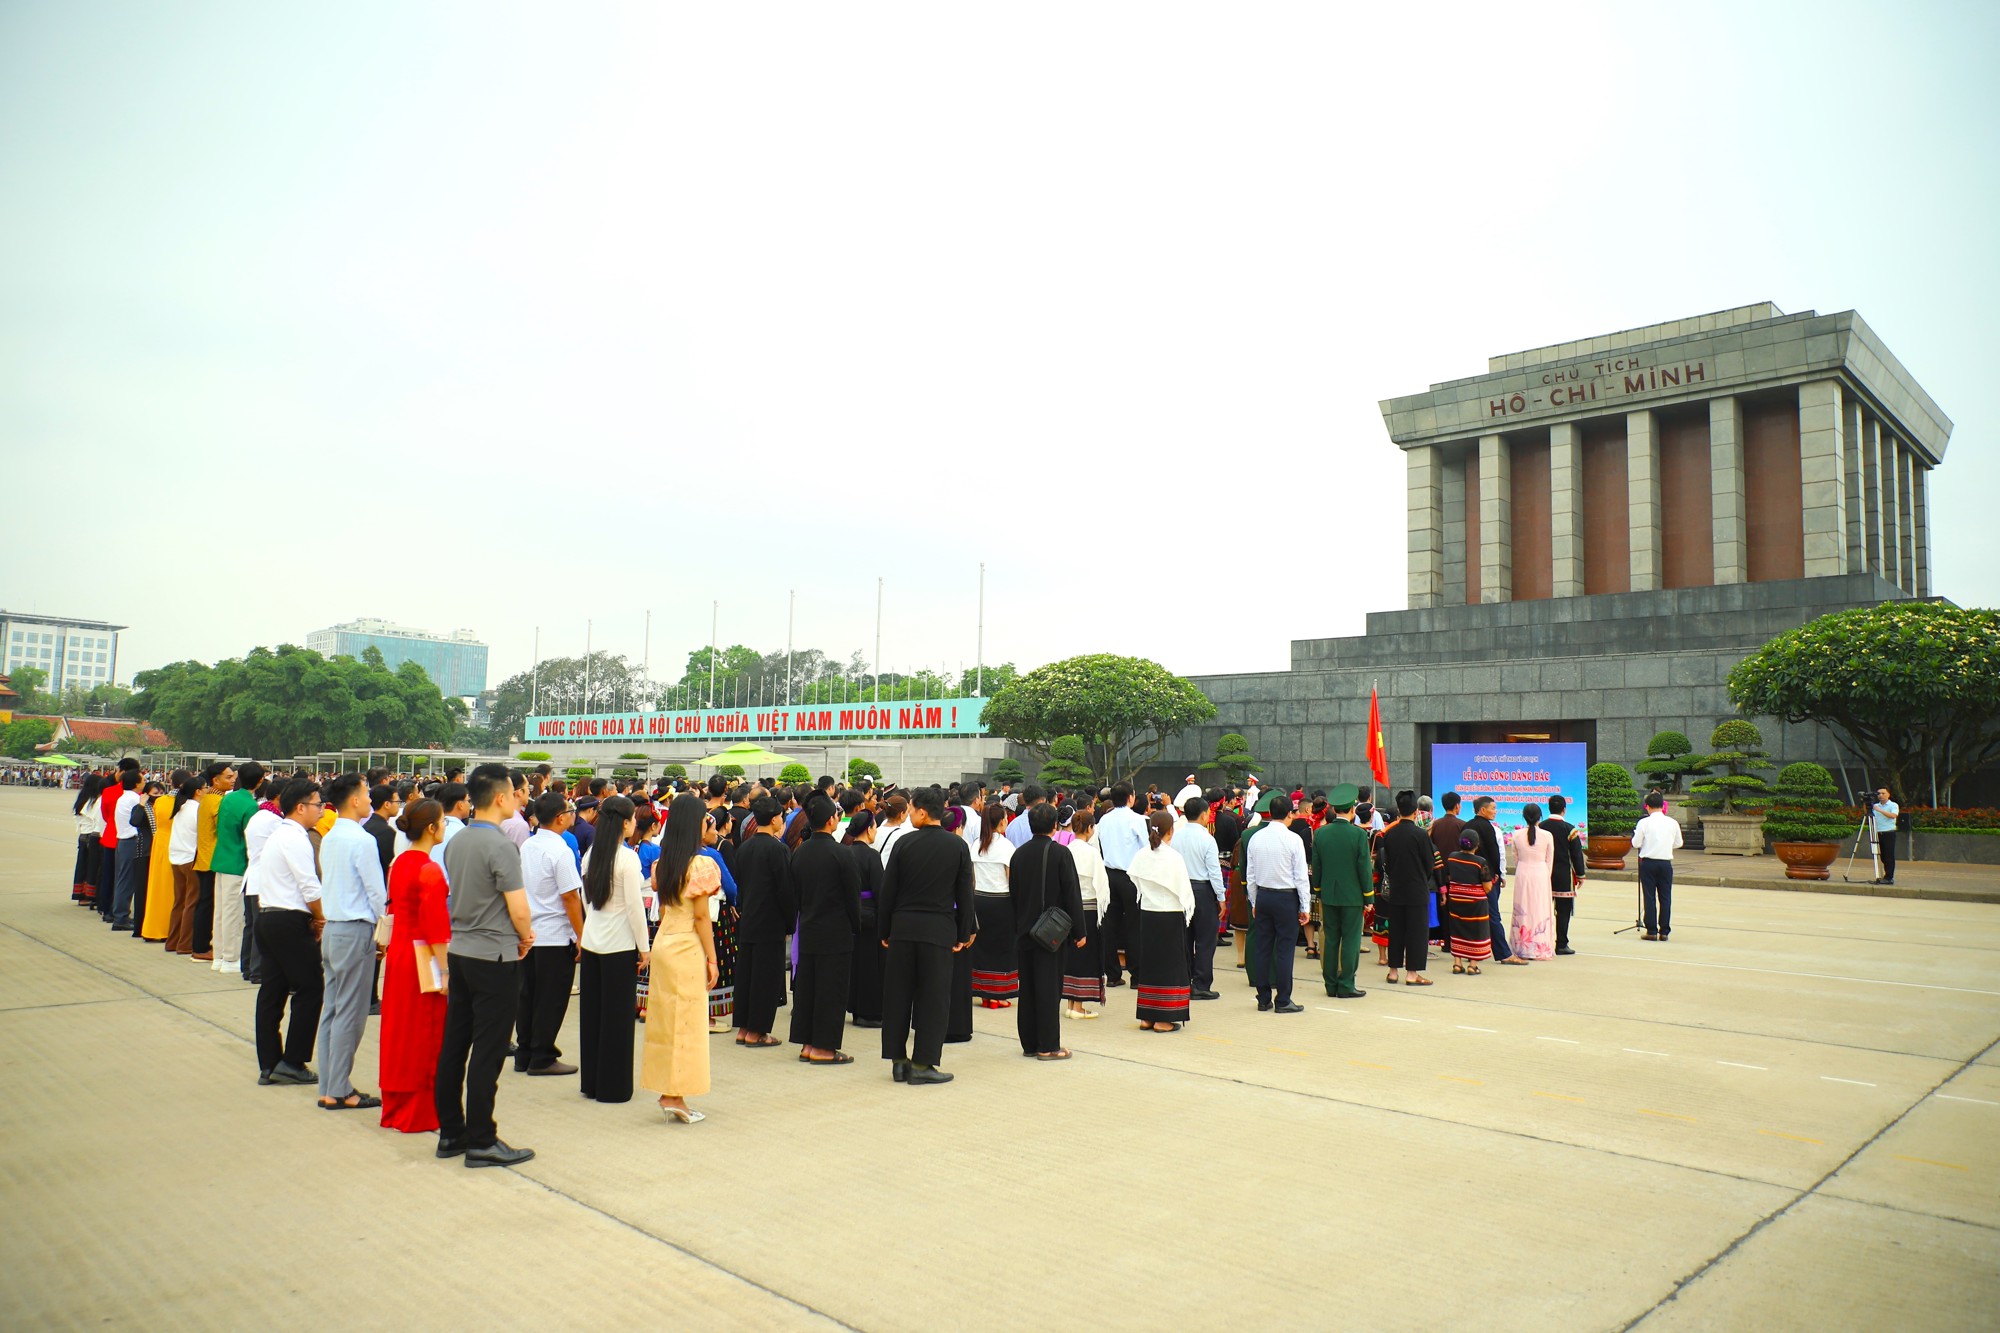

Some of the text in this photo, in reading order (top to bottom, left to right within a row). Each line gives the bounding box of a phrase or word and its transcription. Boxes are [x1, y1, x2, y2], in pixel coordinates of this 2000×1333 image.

[1542, 357, 1639, 385] CHỦ TỊCH
[1489, 390, 1526, 417] HỒ
[1550, 376, 1597, 406] CHÍ
[1624, 362, 1705, 394] MINH
[538, 718, 565, 736] NƯỚC
[569, 716, 598, 739] CỘNG
[602, 715, 625, 735] HÒA
[629, 714, 645, 735] XÃ
[649, 713, 671, 737] HỘI
[675, 709, 701, 734] CHỦ
[706, 711, 749, 733] NGHĨA
[757, 709, 789, 735] VIỆT
[796, 711, 832, 731] NAM
[839, 705, 891, 730] MUÔN
[899, 703, 942, 729] NĂM
[1463, 766, 1550, 781] LỄ BÁO CÔNG DÂNG BÁC
